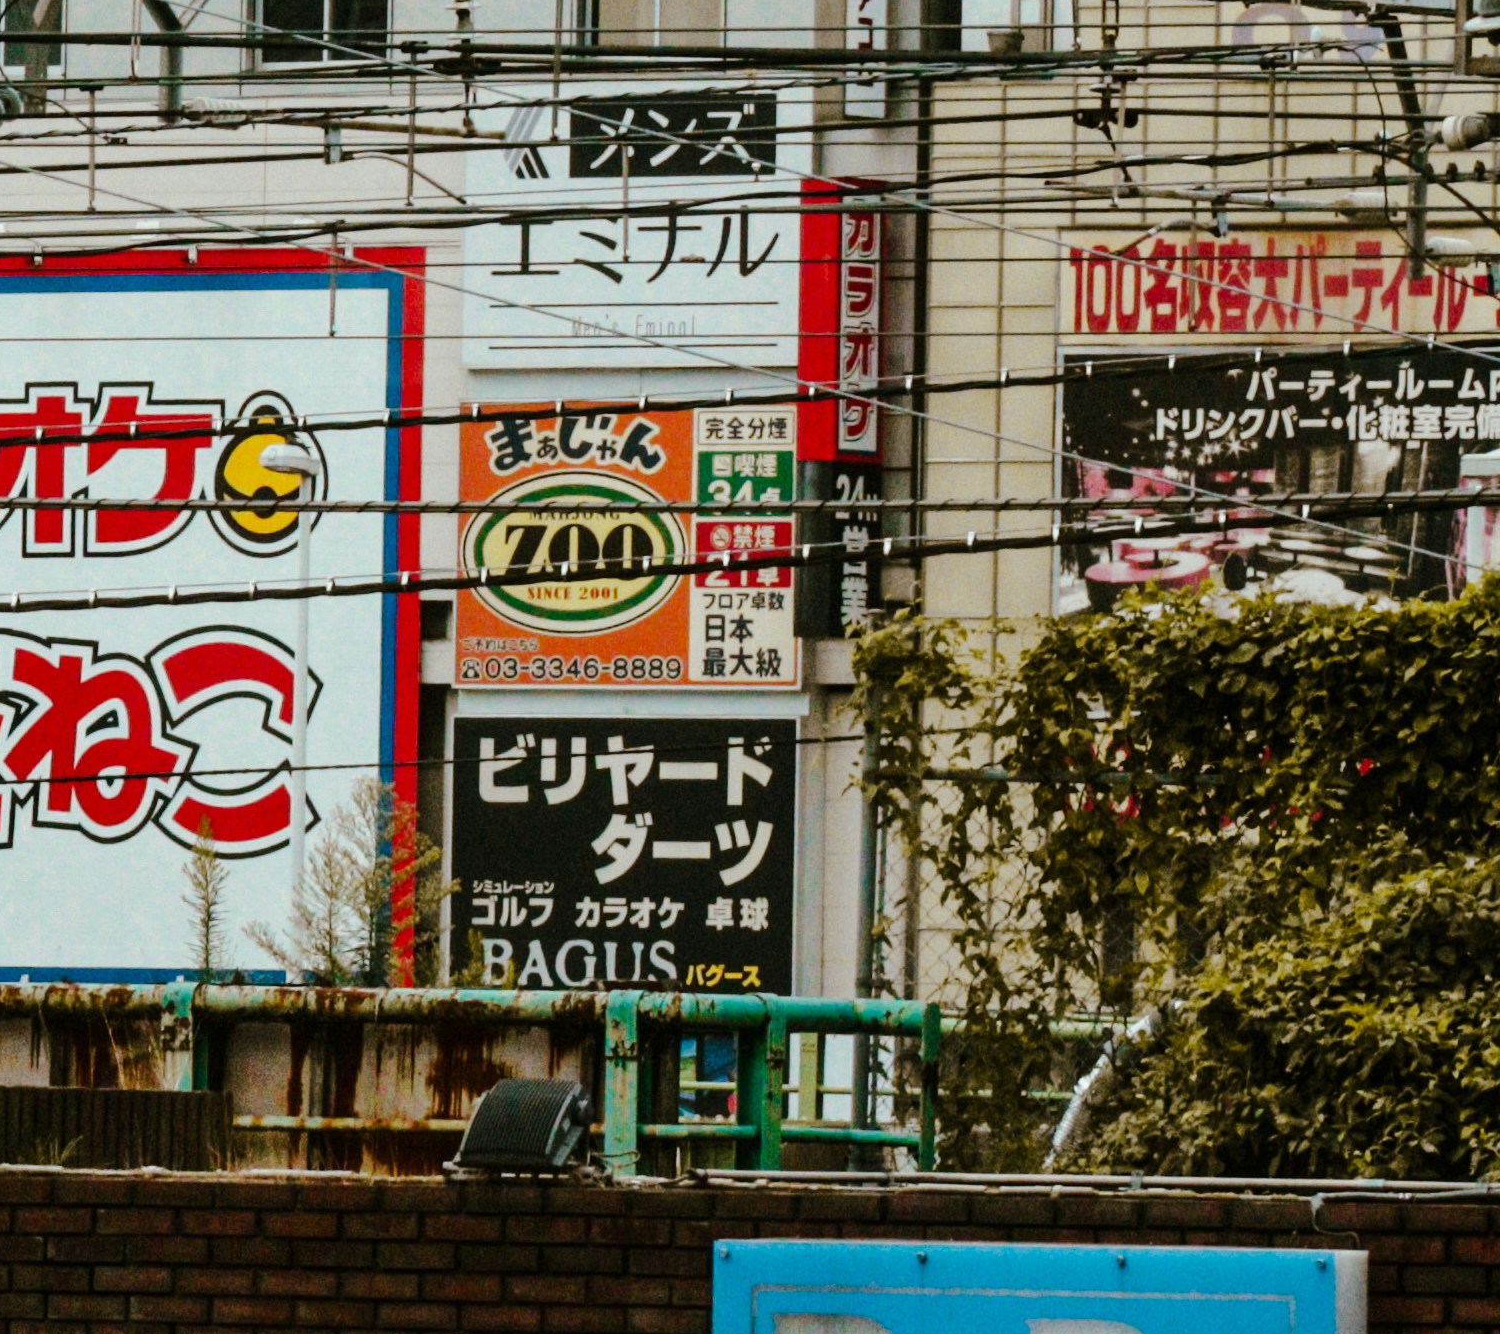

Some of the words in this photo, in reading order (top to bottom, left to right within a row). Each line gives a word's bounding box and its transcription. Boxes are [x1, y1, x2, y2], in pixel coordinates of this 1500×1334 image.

[589, 102, 758, 170] メンズ
[491, 203, 780, 284] エミナル
[1069, 234, 1500, 334] 100名収容大パーティールー
[843, 198, 879, 444] カラオケ
[704, 416, 788, 440] 完全分煙
[734, 453, 779, 478] 喫煙
[732, 524, 776, 548] 禁煙
[503, 523, 656, 582] ZOO
[527, 585, 573, 602] SINCE
[578, 585, 620, 601] 2001
[702, 590, 785, 612] フロア卓数
[704, 613, 754, 643] 日本
[484, 656, 683, 681] 03-3346-8889
[701, 648, 783, 679] 最大級
[478, 732, 775, 807] ビリヤード
[590, 811, 775, 887] ダーツ
[472, 879, 556, 896] シミュレーション
[471, 895, 555, 928] ゴルフ
[575, 896, 686, 930] カラオケ
[705, 896, 770, 932] 卓球
[480, 938, 679, 987] BAGUS
[685, 963, 763, 988] バグース
